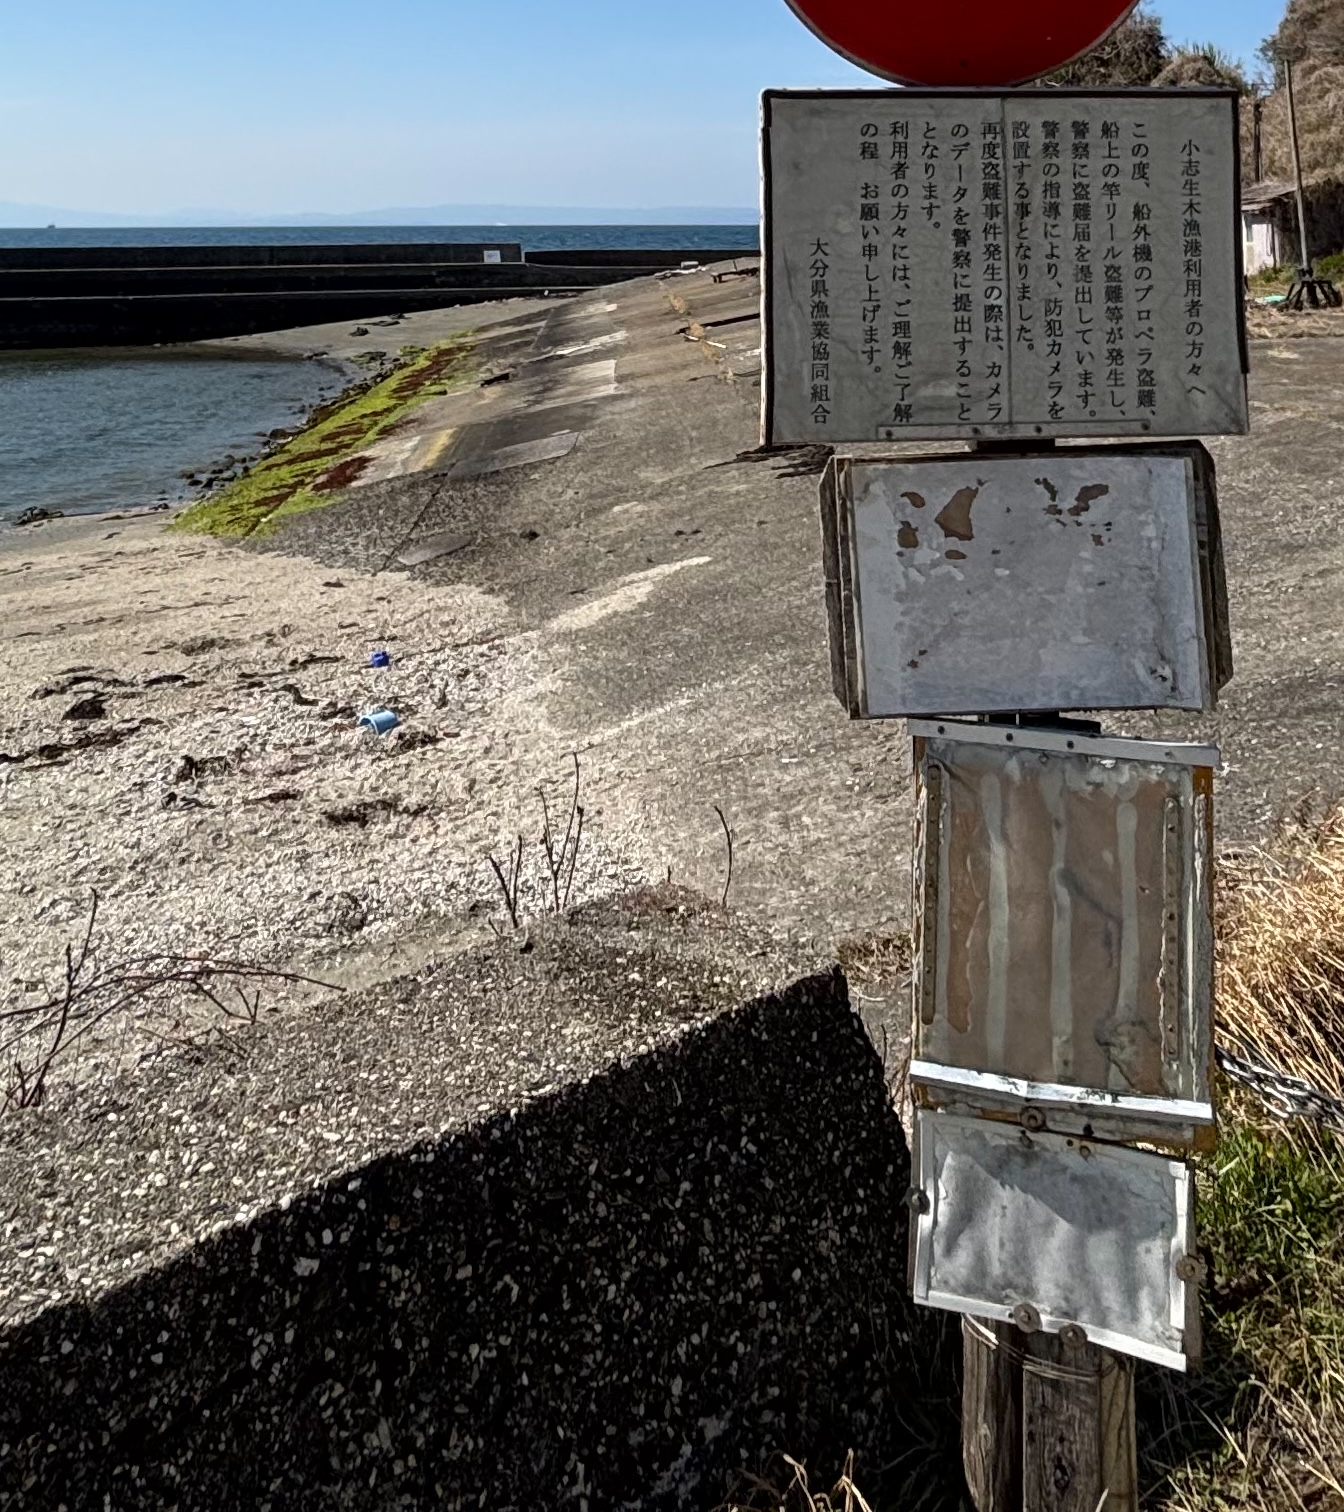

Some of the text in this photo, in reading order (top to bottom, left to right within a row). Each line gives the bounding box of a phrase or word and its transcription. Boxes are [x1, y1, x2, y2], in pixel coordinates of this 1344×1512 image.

[920, 121, 942, 230] となります。
[950, 123, 973, 421] のデータを警察に提出すること
[1012, 121, 1035, 351] 設置する事となりました。
[1180, 139, 1206, 395] 小志生木漁港利用者の方々へ
[810, 237, 831, 424] 大分県漁業協同組合
